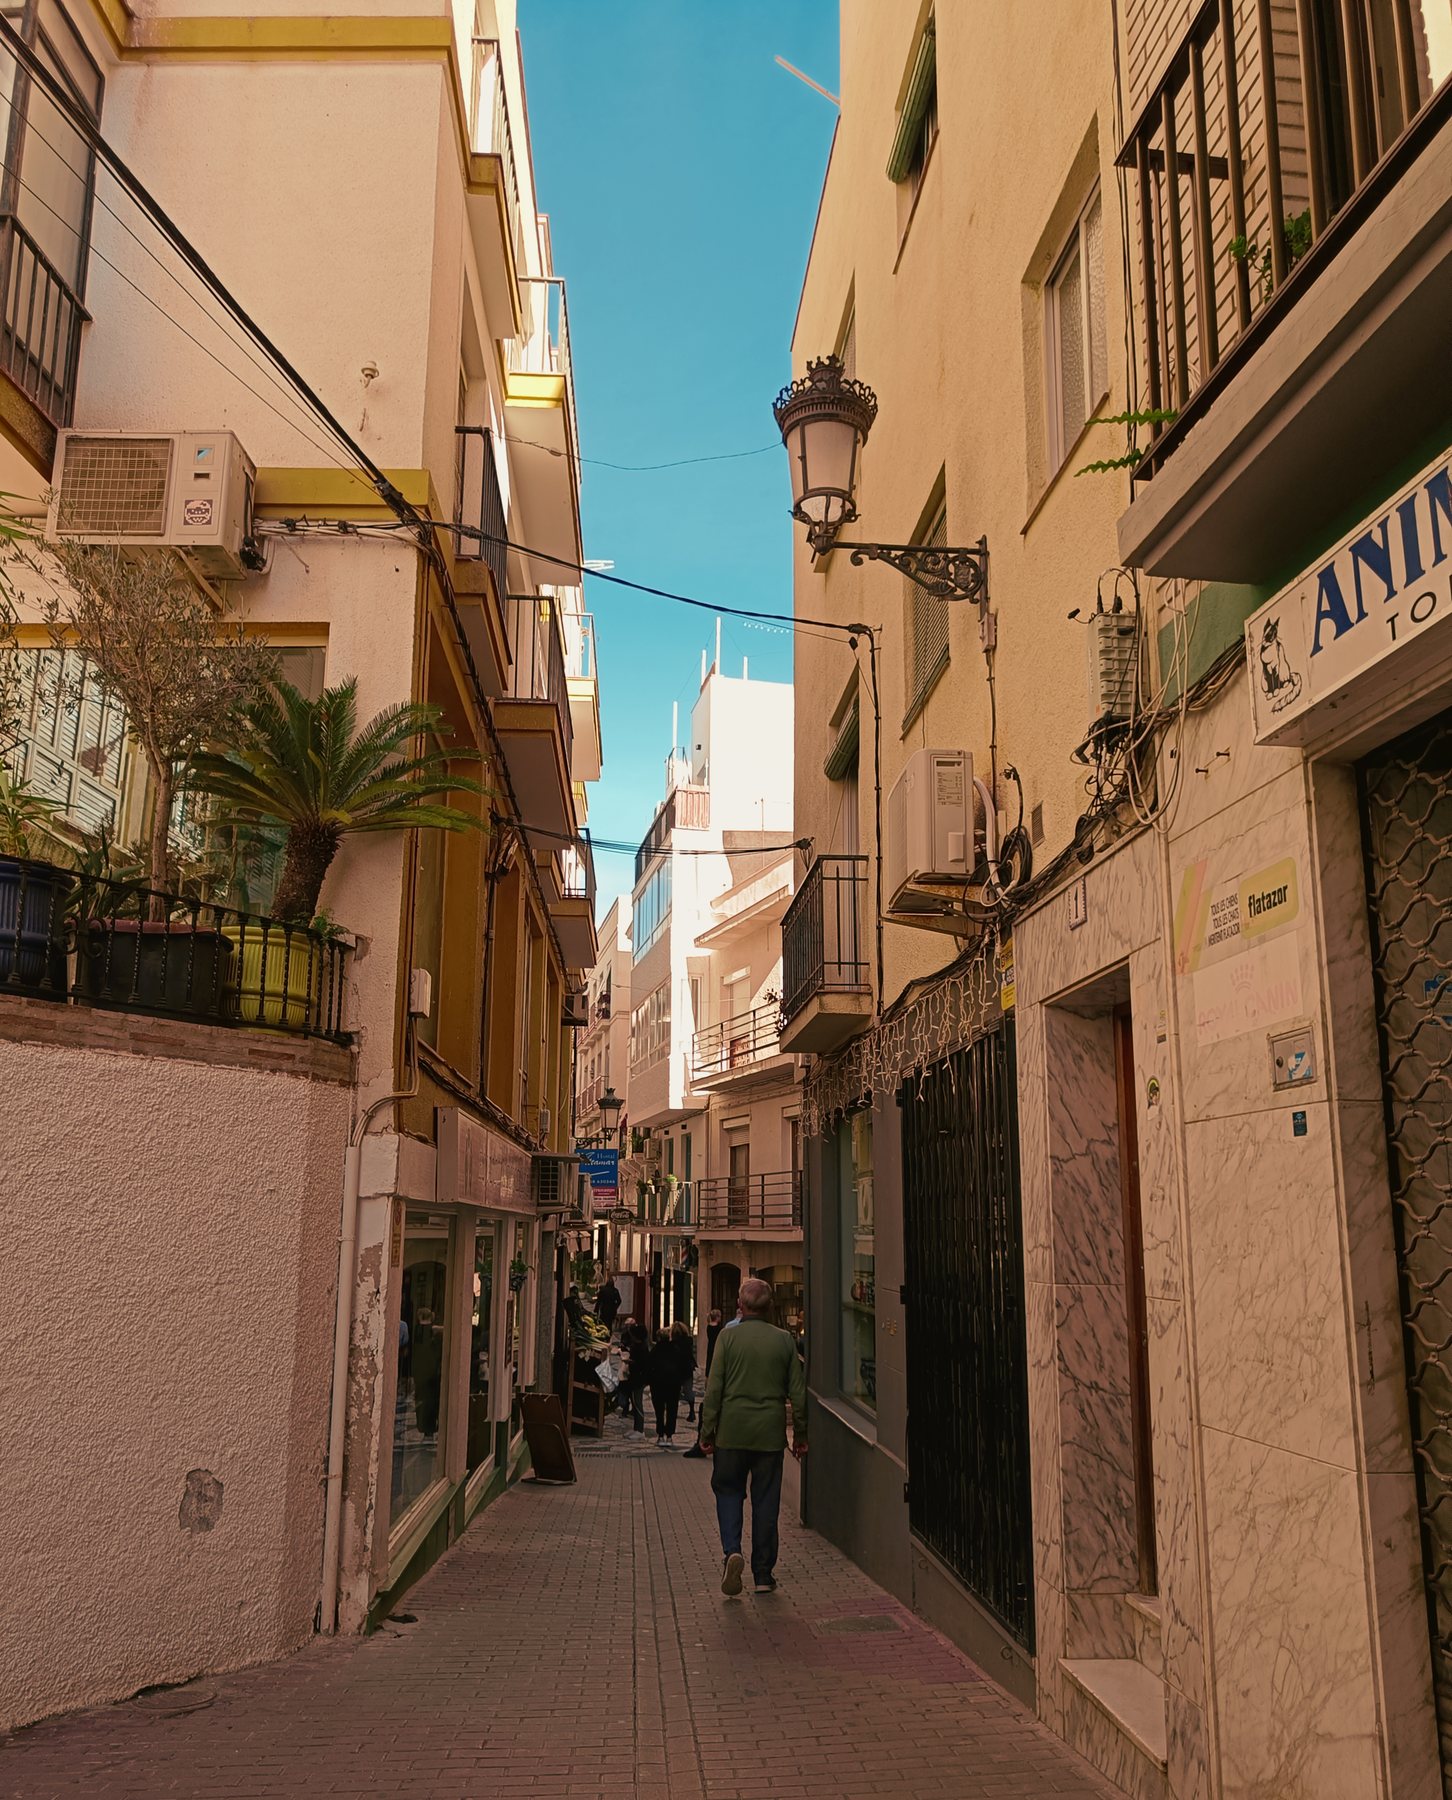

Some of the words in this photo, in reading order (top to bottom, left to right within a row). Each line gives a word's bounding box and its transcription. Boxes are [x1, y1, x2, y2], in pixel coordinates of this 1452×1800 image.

[1386, 575, 1452, 640] TO
[1247, 884, 1289, 918] flatazor
[1244, 979, 1298, 1021] CANIN
